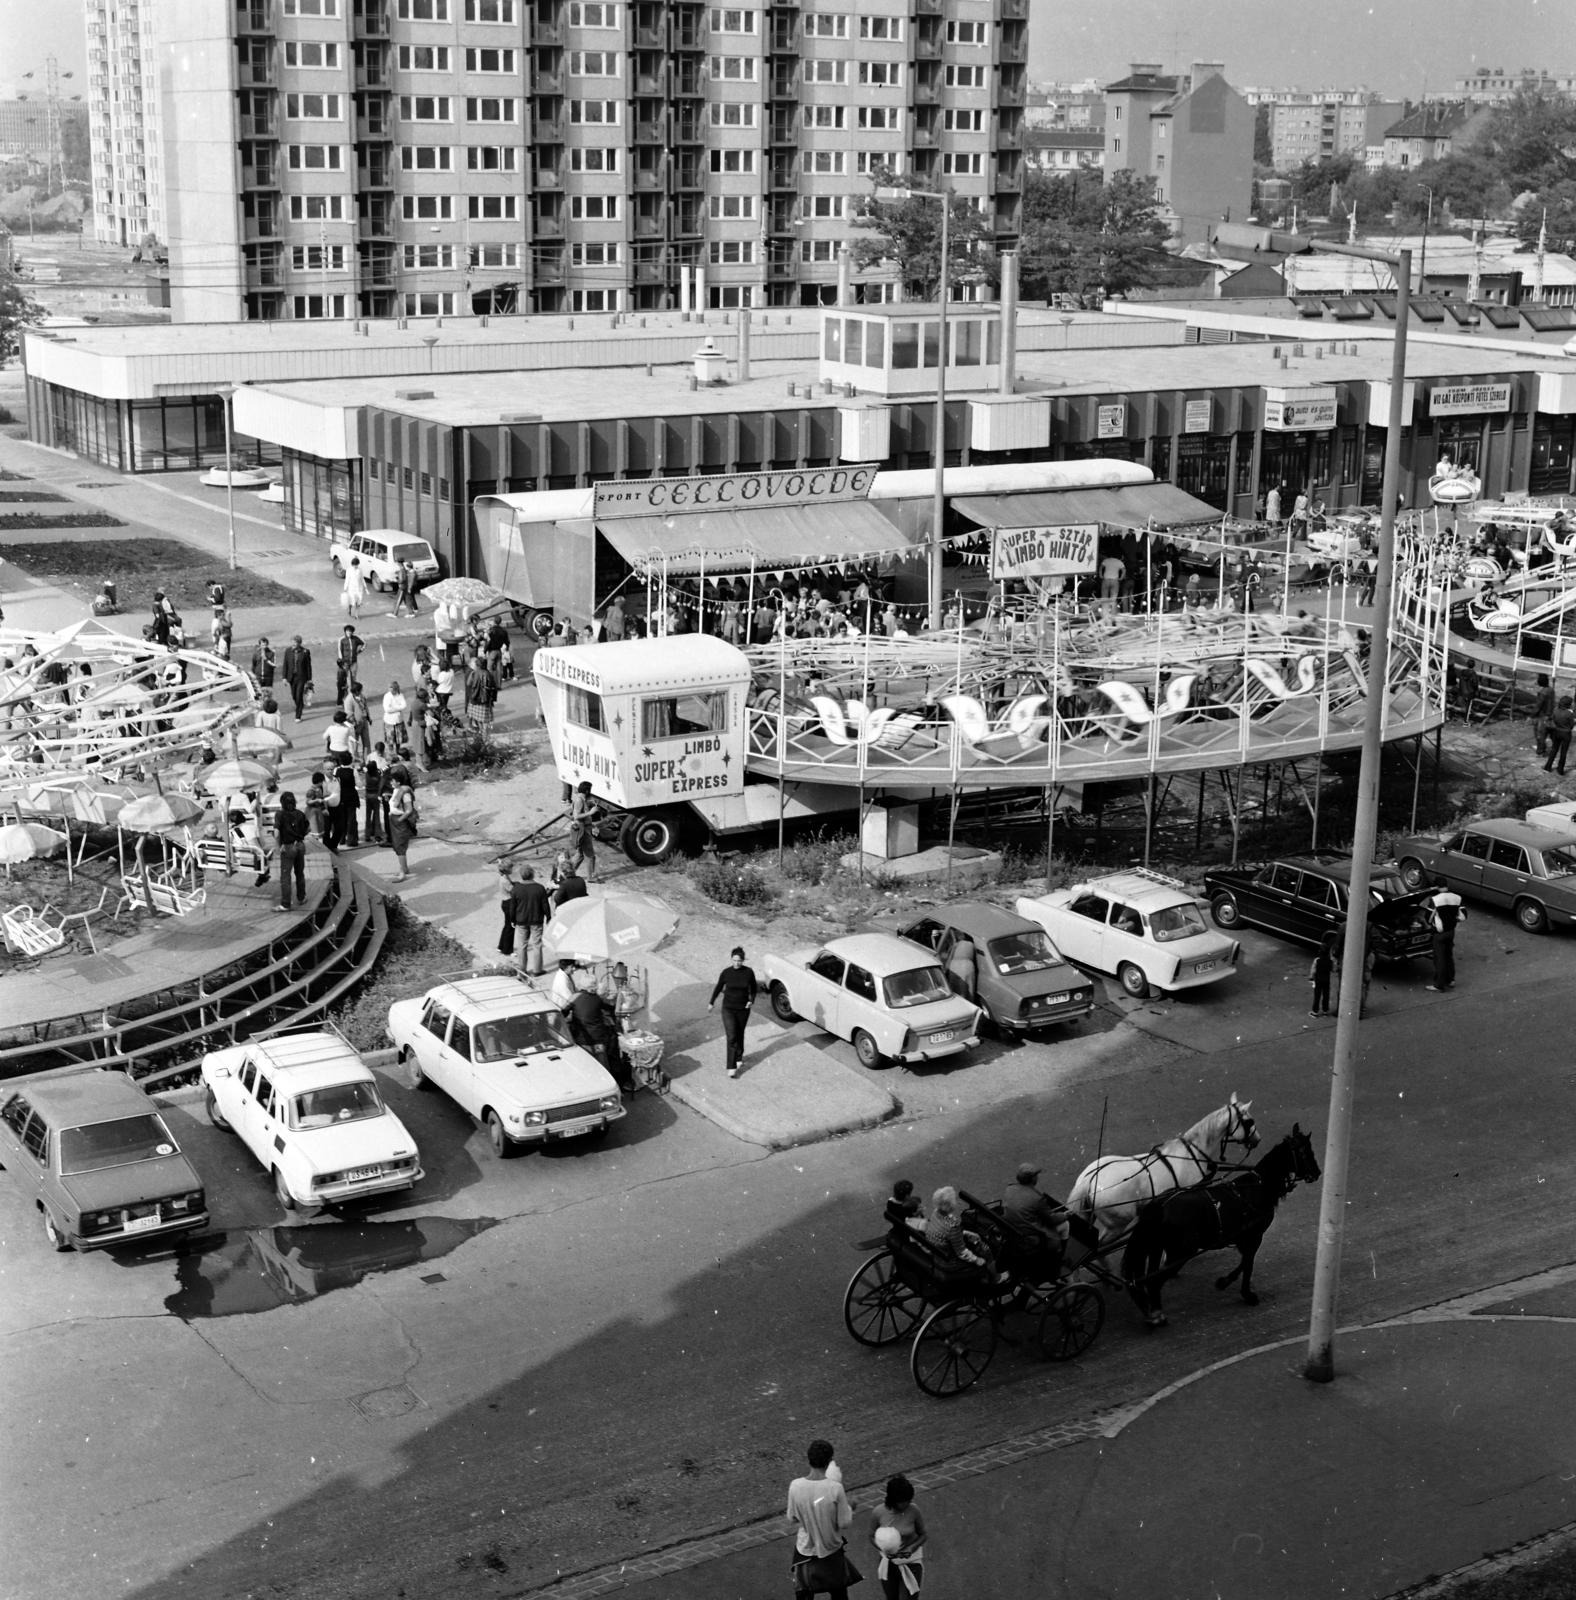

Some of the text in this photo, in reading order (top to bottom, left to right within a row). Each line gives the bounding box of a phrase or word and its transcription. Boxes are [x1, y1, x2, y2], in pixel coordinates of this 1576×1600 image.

[598, 492, 642, 502] SPORT
[1059, 528, 1092, 547] SZTÁR
[1049, 541, 1087, 563] HINTÓ
[539, 653, 601, 688] SUPER EXPRESS
[594, 753, 621, 782] HINT
[634, 760, 675, 783] SUPER
[672, 774, 728, 793] EXPRESS
